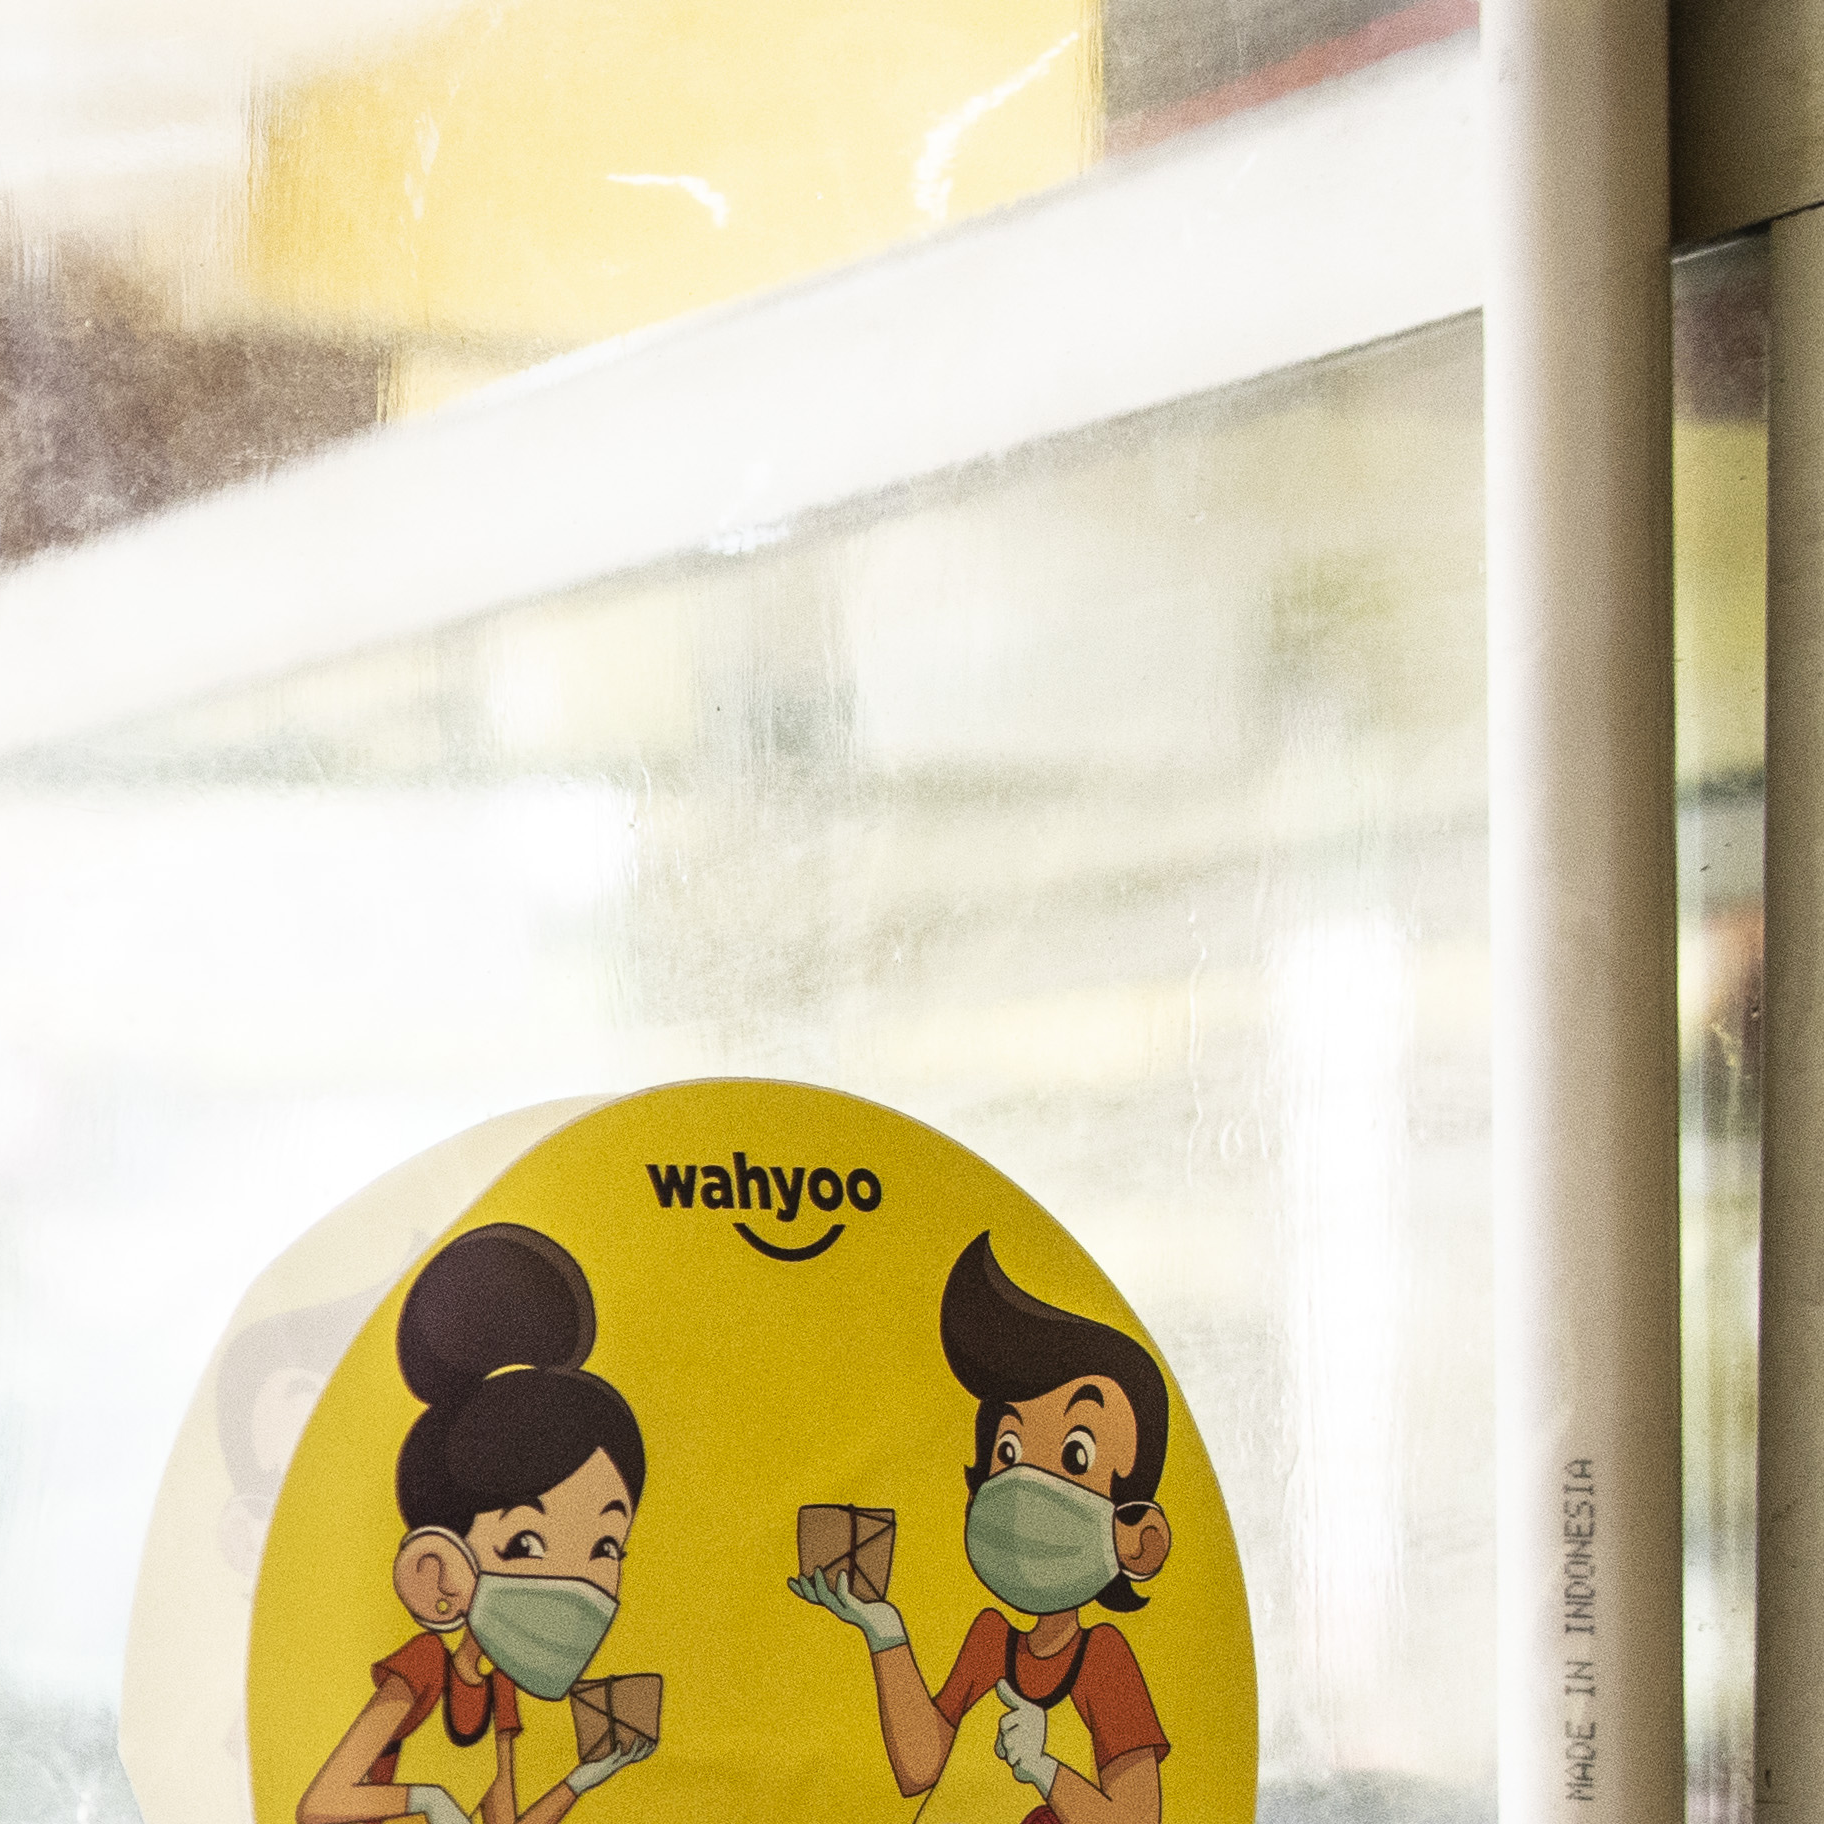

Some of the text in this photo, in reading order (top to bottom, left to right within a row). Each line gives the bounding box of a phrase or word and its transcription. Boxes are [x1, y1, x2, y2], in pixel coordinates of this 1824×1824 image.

[645, 1151, 883, 1223] wahyoo
[1562, 1458, 1596, 1637] INDONESIA
[1563, 1660, 1596, 1698] IN
[1563, 1720, 1596, 1801] MADE
